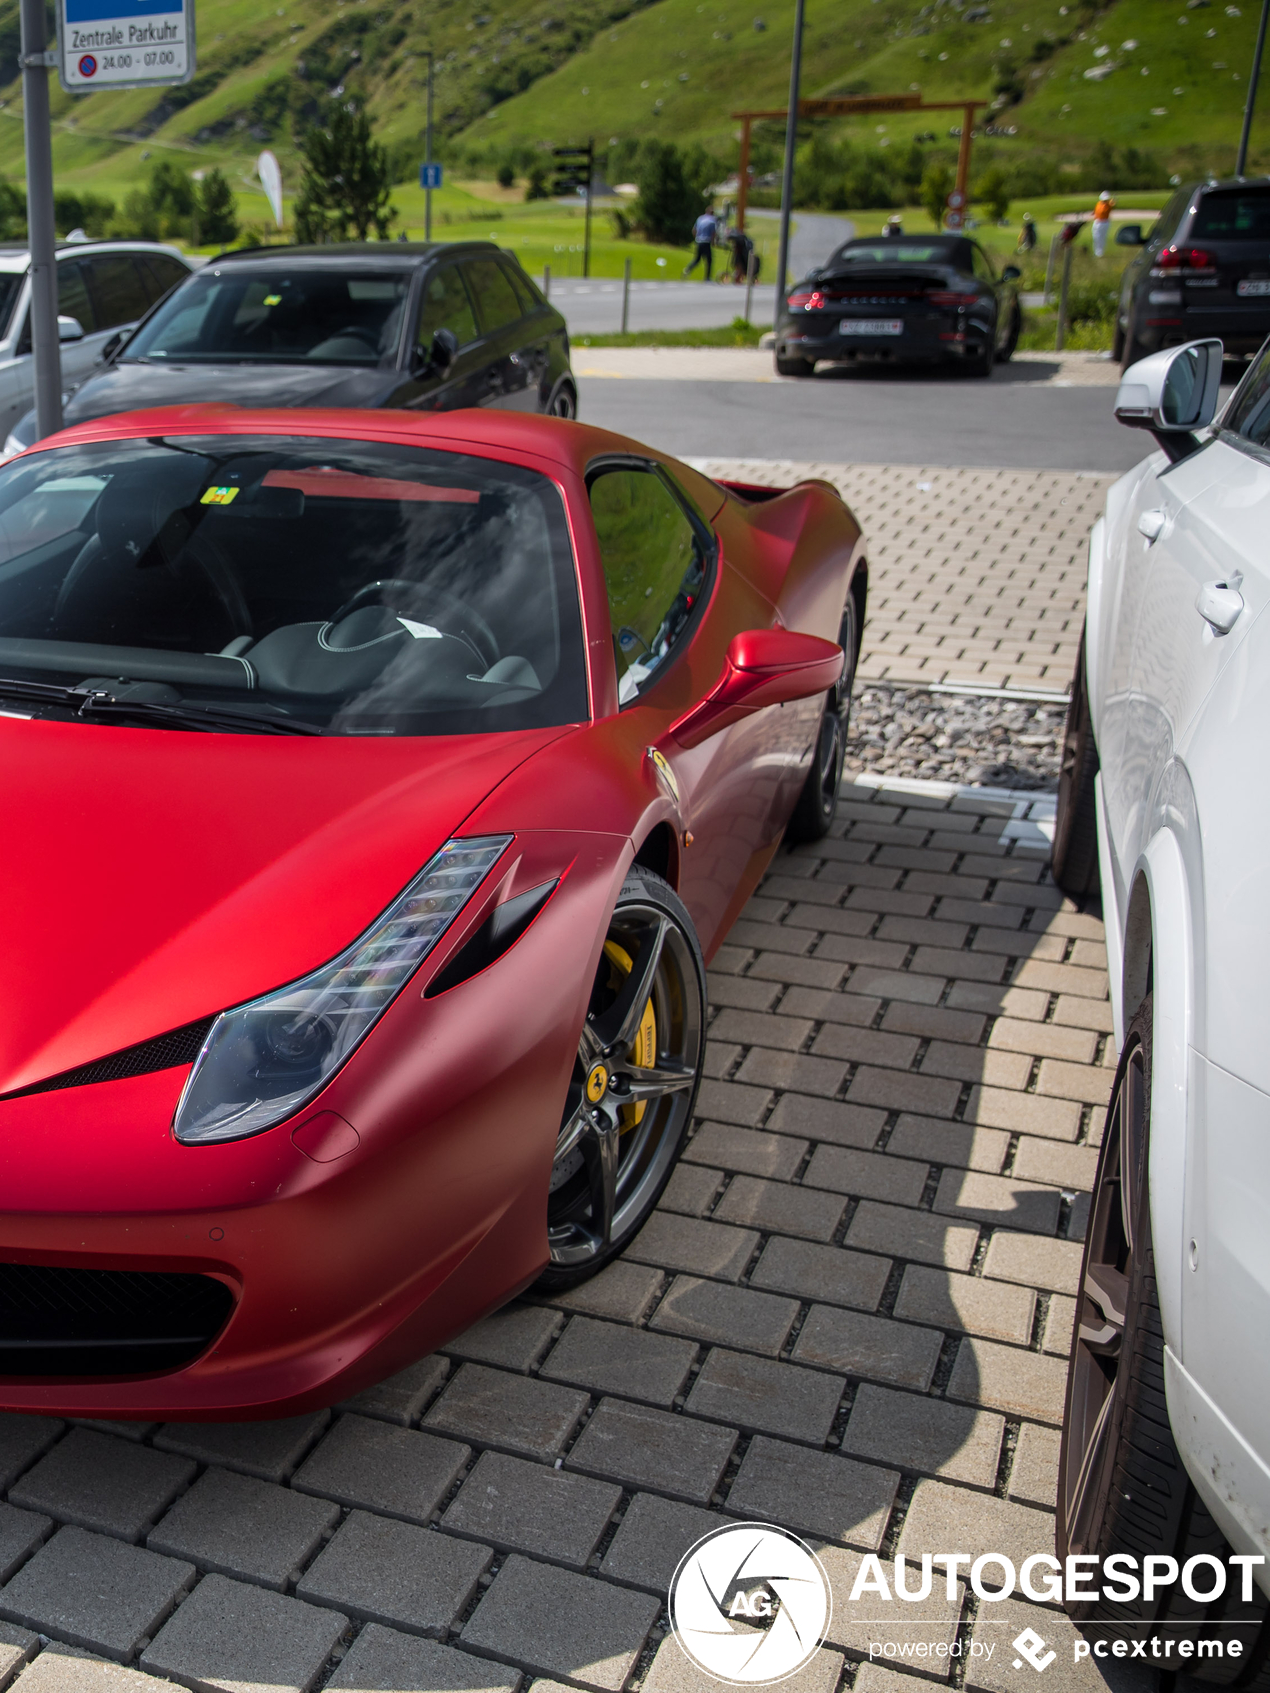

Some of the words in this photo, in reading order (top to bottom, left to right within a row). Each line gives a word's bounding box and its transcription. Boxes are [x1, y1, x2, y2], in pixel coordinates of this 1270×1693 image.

[72, 26, 124, 48] Zentrale
[129, 20, 178, 43] Parkuhr
[102, 55, 132, 70] 24.00
[143, 51, 175, 67] 07.00
